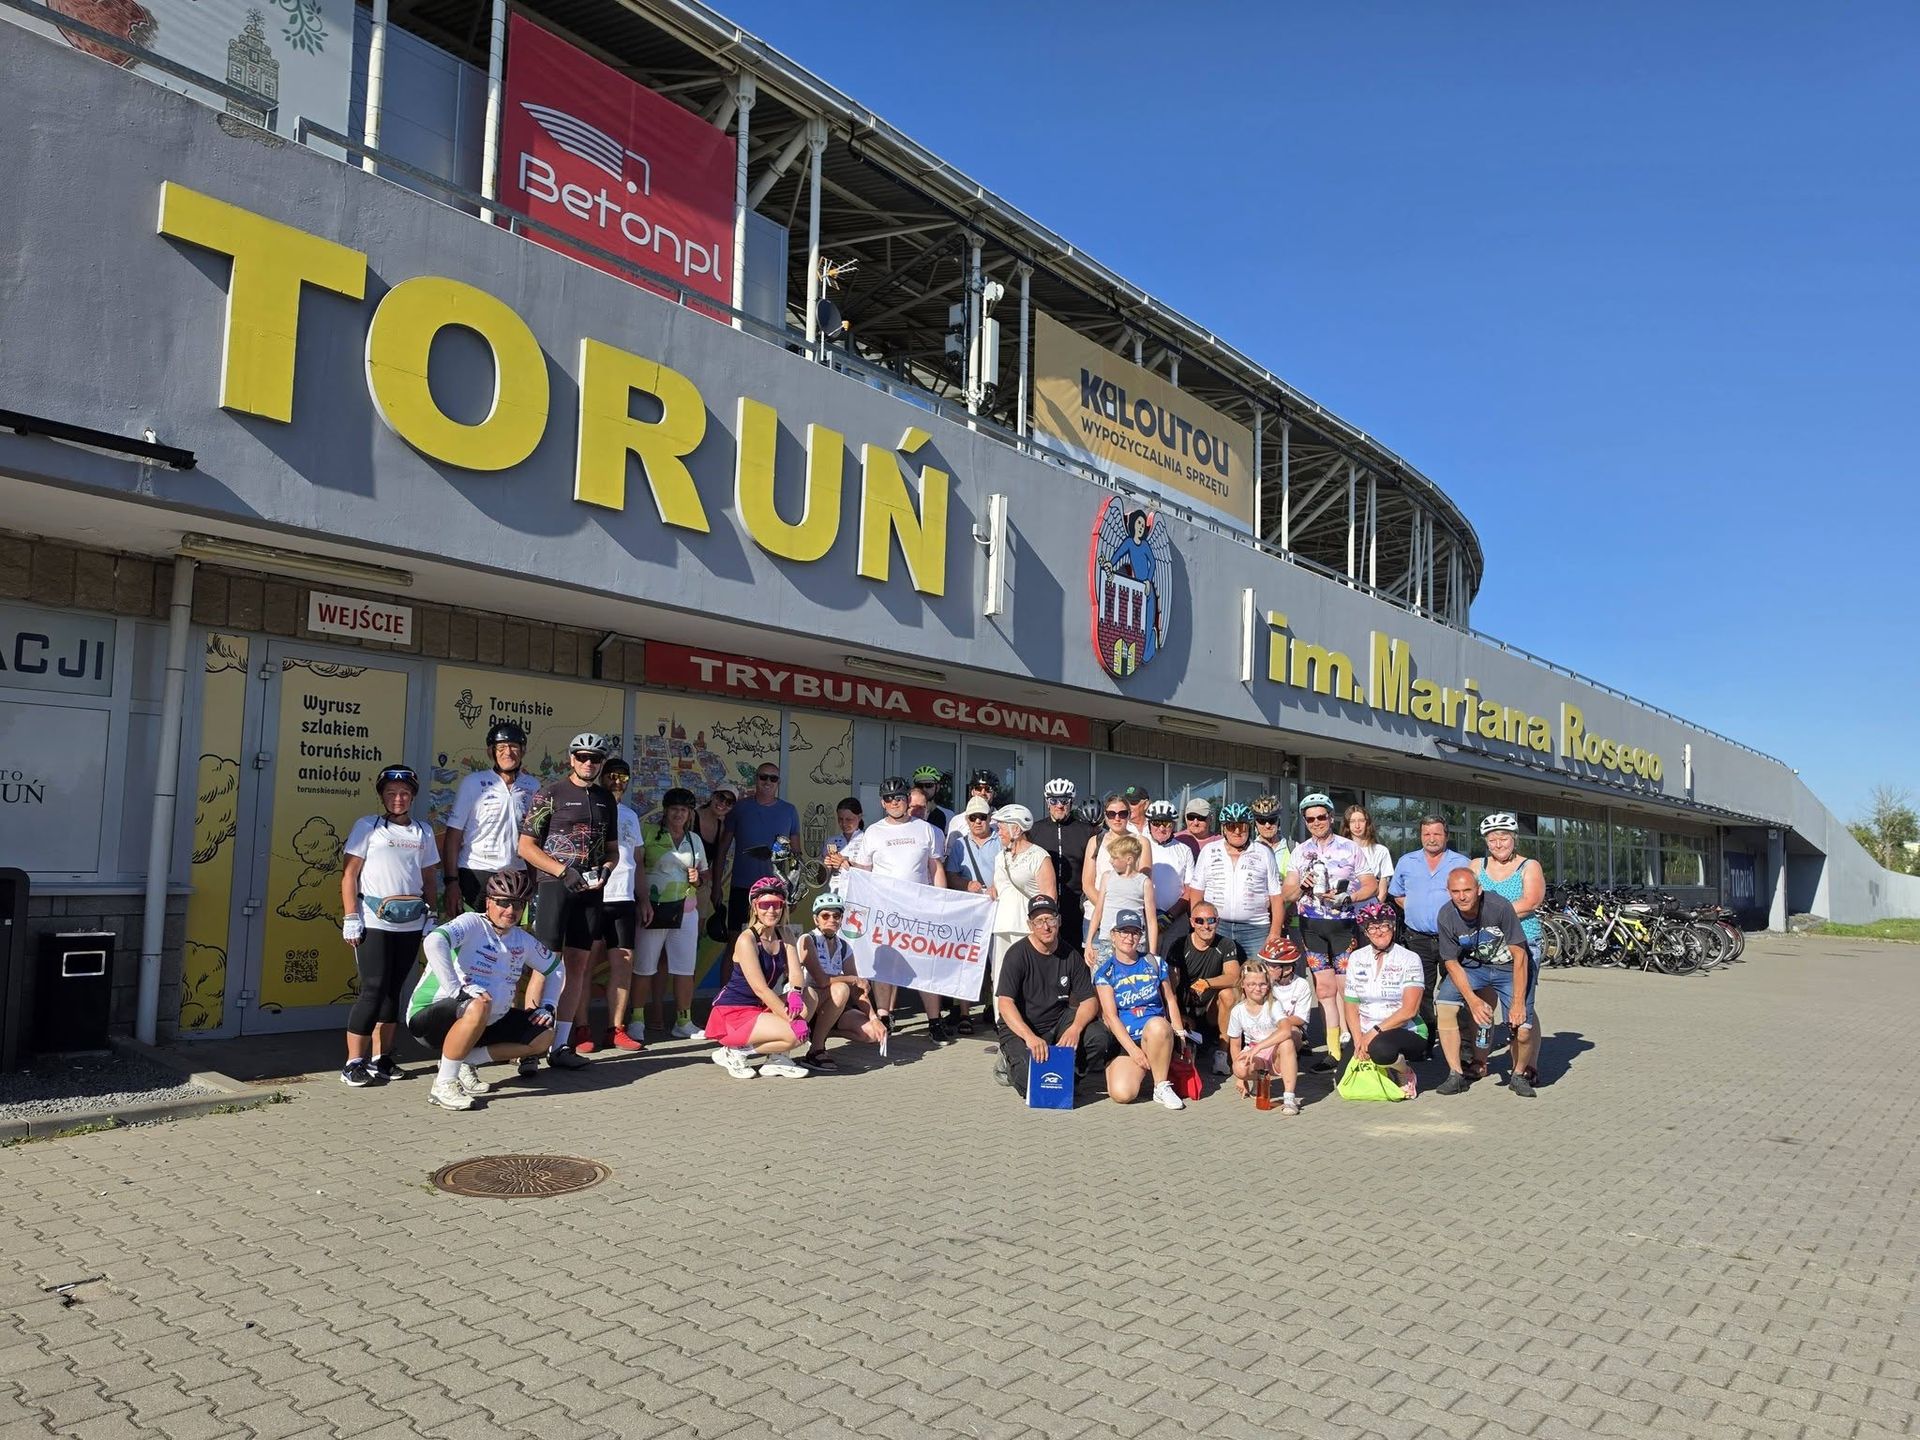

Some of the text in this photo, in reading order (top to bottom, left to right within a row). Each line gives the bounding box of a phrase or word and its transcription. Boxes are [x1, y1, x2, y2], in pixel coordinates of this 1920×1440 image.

[518, 151, 723, 283] Betonpl
[157, 181, 949, 597] TORUŃ
[1081, 416, 1229, 498] WYPOŻYCZALNIA SPRZĘTU
[318, 602, 404, 634] WEJŚCIE
[0, 632, 104, 680] CJI
[303, 694, 361, 716] Wyrusz
[489, 696, 553, 717] Toruńskie
[690, 656, 1071, 738] TRYBUNA GŁÓWNA
[1370, 630, 1551, 753] Mariana
[302, 719, 369, 738] szlakiem
[300, 741, 382, 761] toruńskich
[298, 765, 361, 783] aniołów
[1731, 866, 1754, 898] TORUŃ
[874, 909, 984, 944] ROWEROWE
[872, 926, 981, 963] ŁYSOMICE
